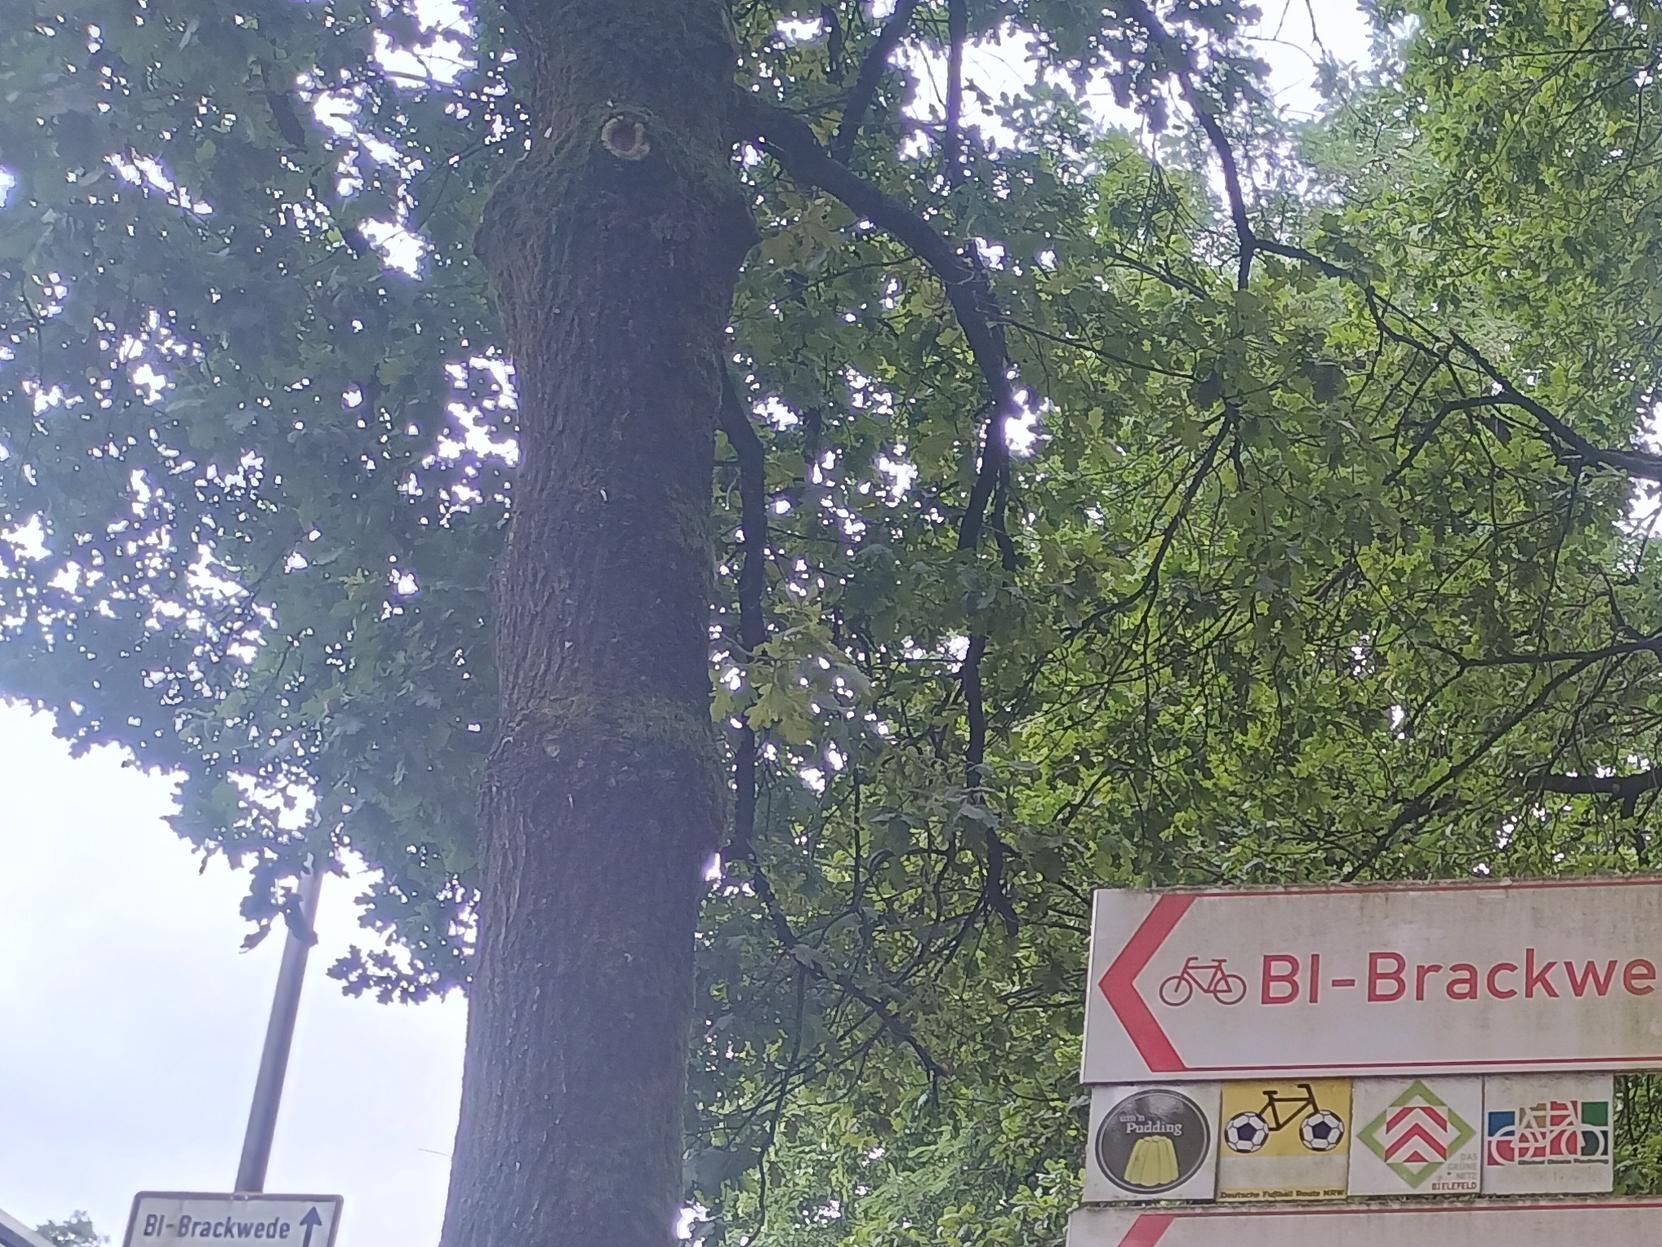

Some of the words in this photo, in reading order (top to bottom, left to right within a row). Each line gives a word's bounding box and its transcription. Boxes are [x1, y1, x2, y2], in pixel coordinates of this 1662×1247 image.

[1126, 1120, 1183, 1136] Pudding
[1432, 1182, 1477, 1190] BIELEFELD
[143, 1214, 290, 1240] BI-Brackwede
